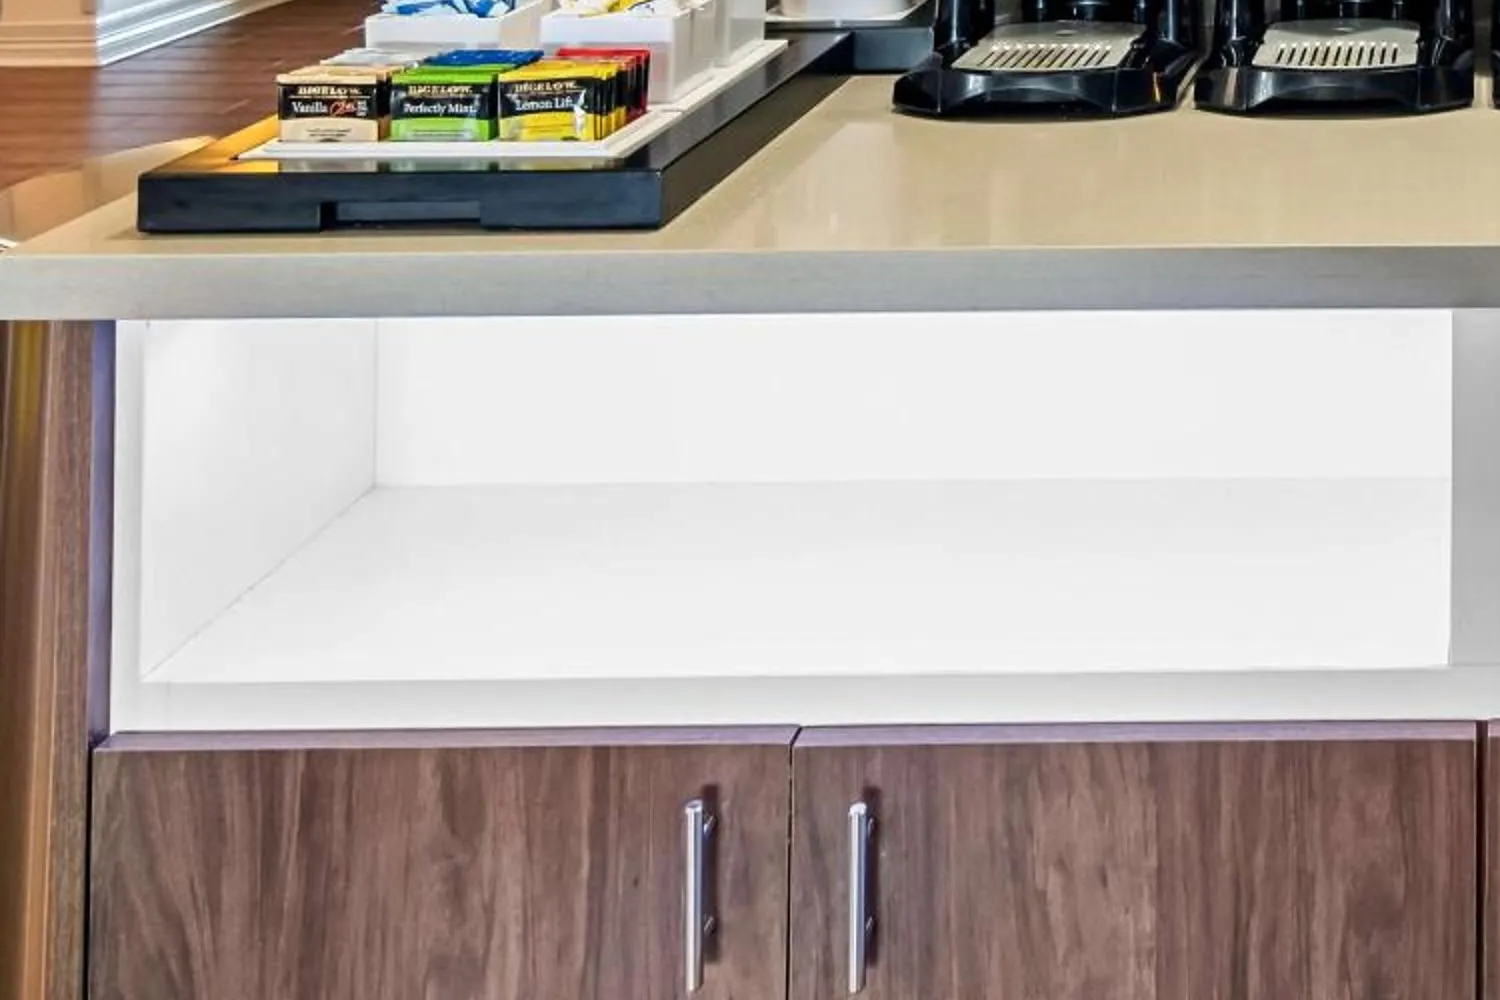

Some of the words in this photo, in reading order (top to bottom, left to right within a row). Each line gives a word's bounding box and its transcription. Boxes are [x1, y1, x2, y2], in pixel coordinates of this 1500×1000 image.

[291, 101, 329, 113] Vanilla
[403, 102, 446, 117] Perfectly
[515, 99, 553, 111] Lemon
